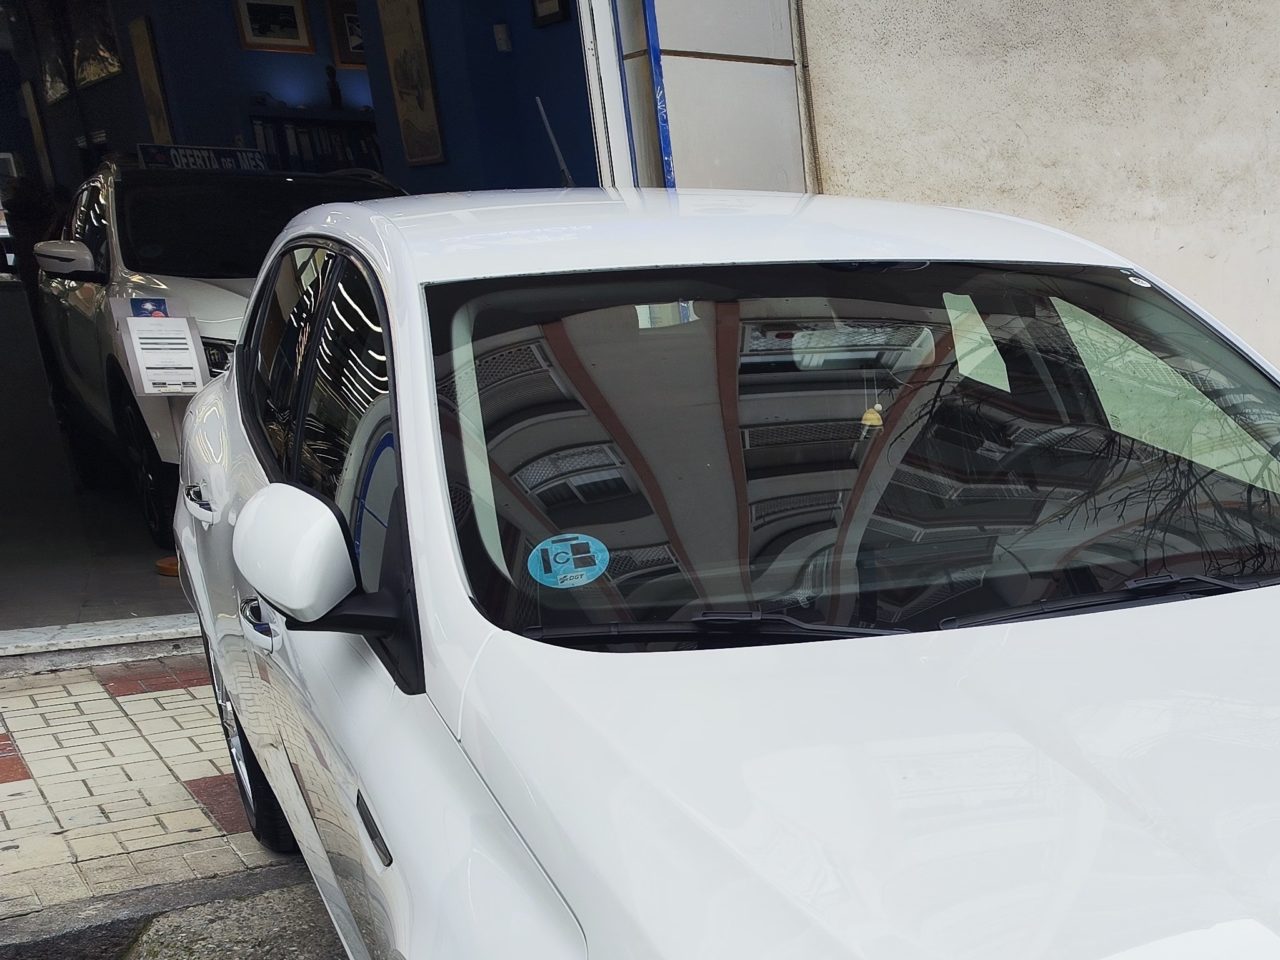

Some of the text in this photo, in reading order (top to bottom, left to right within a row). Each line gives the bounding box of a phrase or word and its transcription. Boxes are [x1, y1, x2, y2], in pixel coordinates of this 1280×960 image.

[170, 148, 218, 169] OFERTA
[237, 152, 265, 170] MES
[569, 573, 584, 581] DGT
